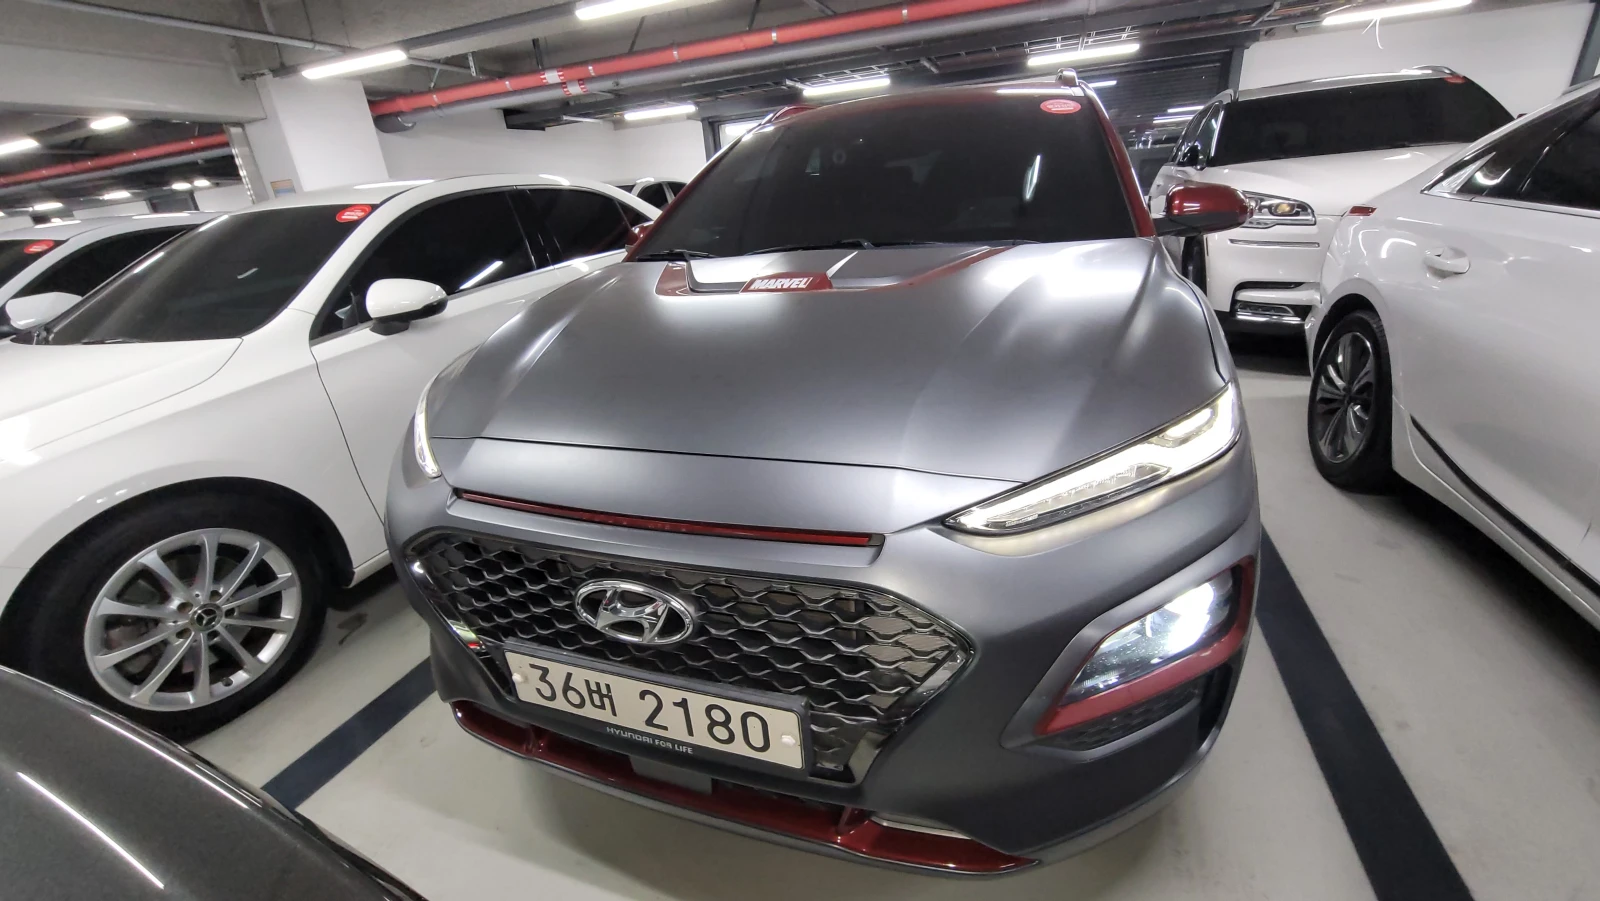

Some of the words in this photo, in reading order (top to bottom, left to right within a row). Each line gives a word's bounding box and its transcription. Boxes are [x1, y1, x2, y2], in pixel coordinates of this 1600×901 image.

[748, 277, 813, 290] MARVEL
[529, 663, 618, 717] 36버
[638, 689, 771, 753] 2180
[606, 726, 653, 744] HYUNDAI
[655, 739, 673, 749] FOR
[674, 744, 694, 755] LIFE
